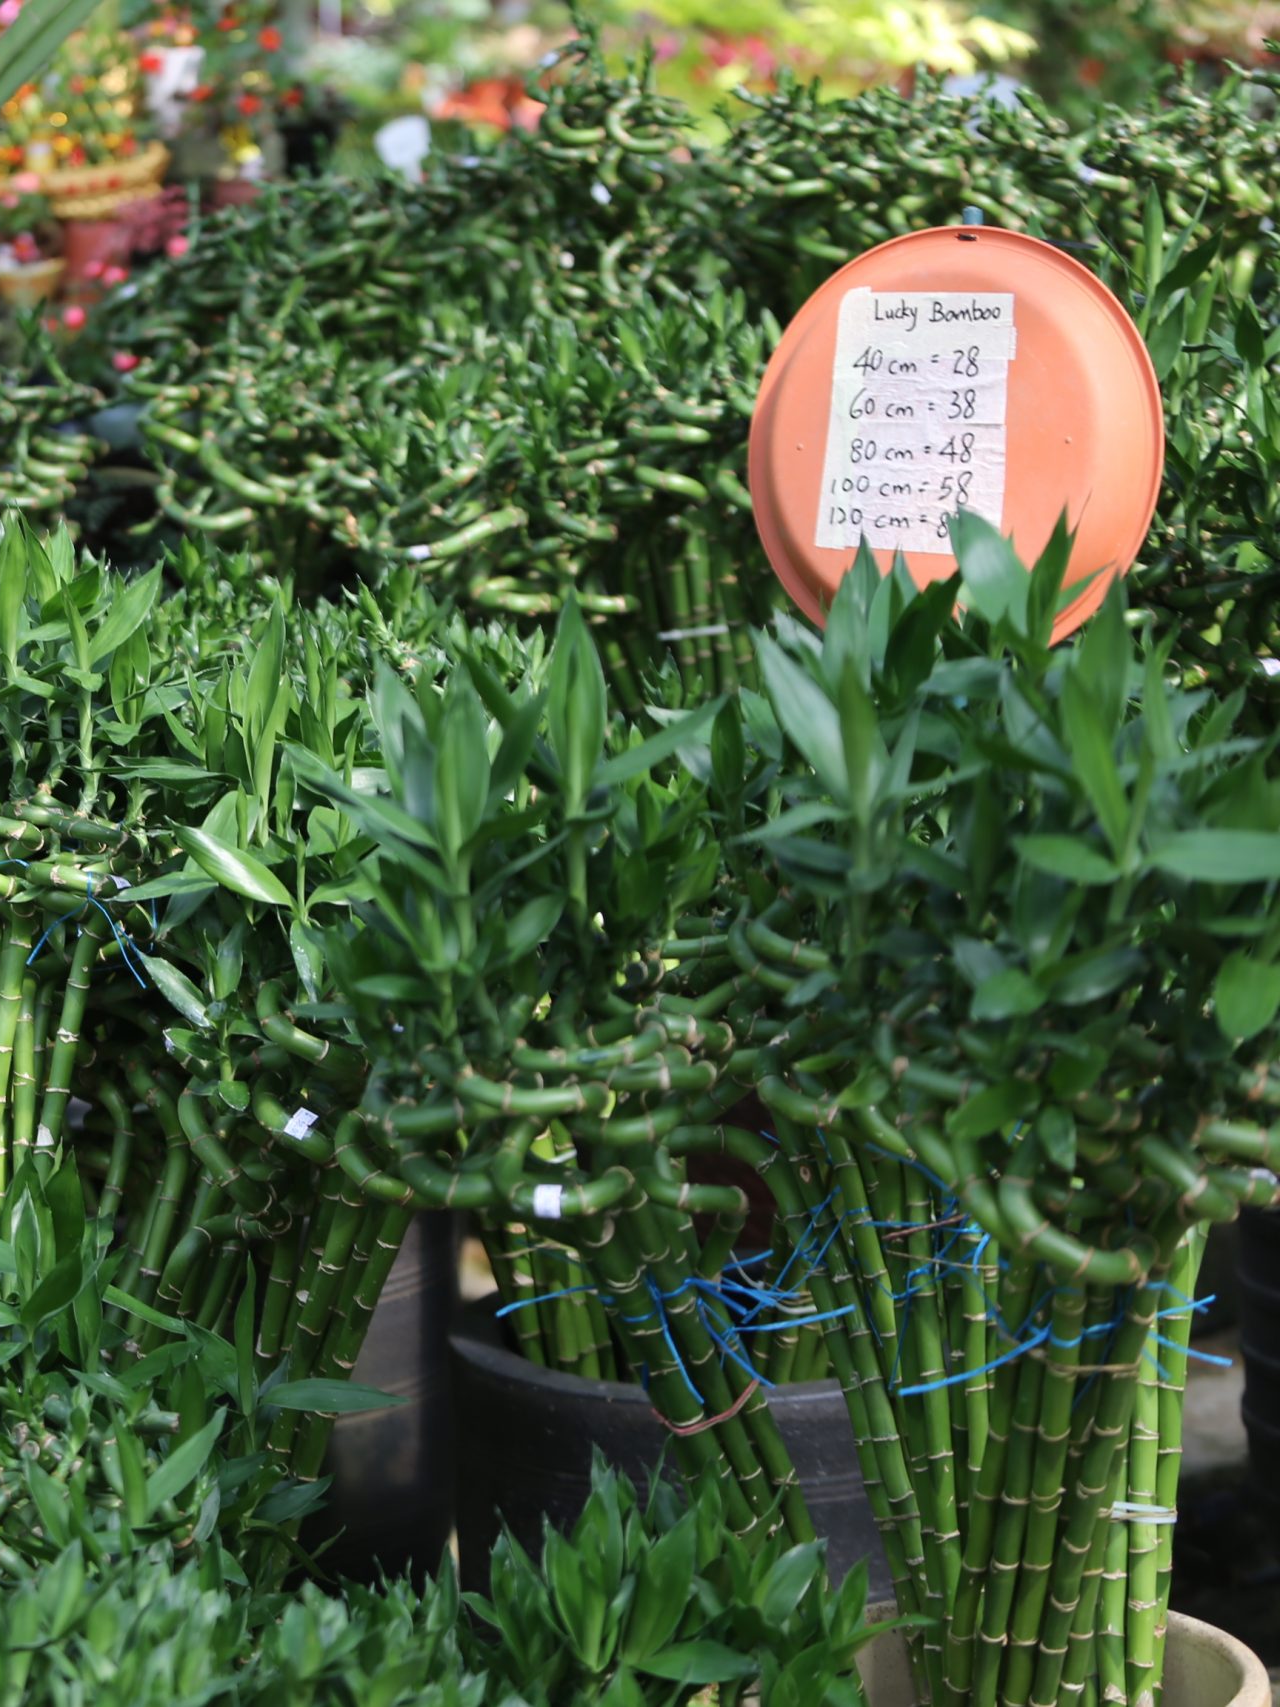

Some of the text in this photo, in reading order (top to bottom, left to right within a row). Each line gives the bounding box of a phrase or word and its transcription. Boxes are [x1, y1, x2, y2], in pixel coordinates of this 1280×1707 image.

[875, 299, 1001, 331] Lucky Bamboo
[853, 345, 980, 377] 40 cm = 28
[849, 388, 976, 420] 60 cm = 38
[850, 432, 975, 463] 80 cm = 48
[831, 471, 973, 505] 100 cm = 58
[874, 511, 911, 528] cm
[920, 513, 928, 523] =
[937, 510, 960, 538] 8
